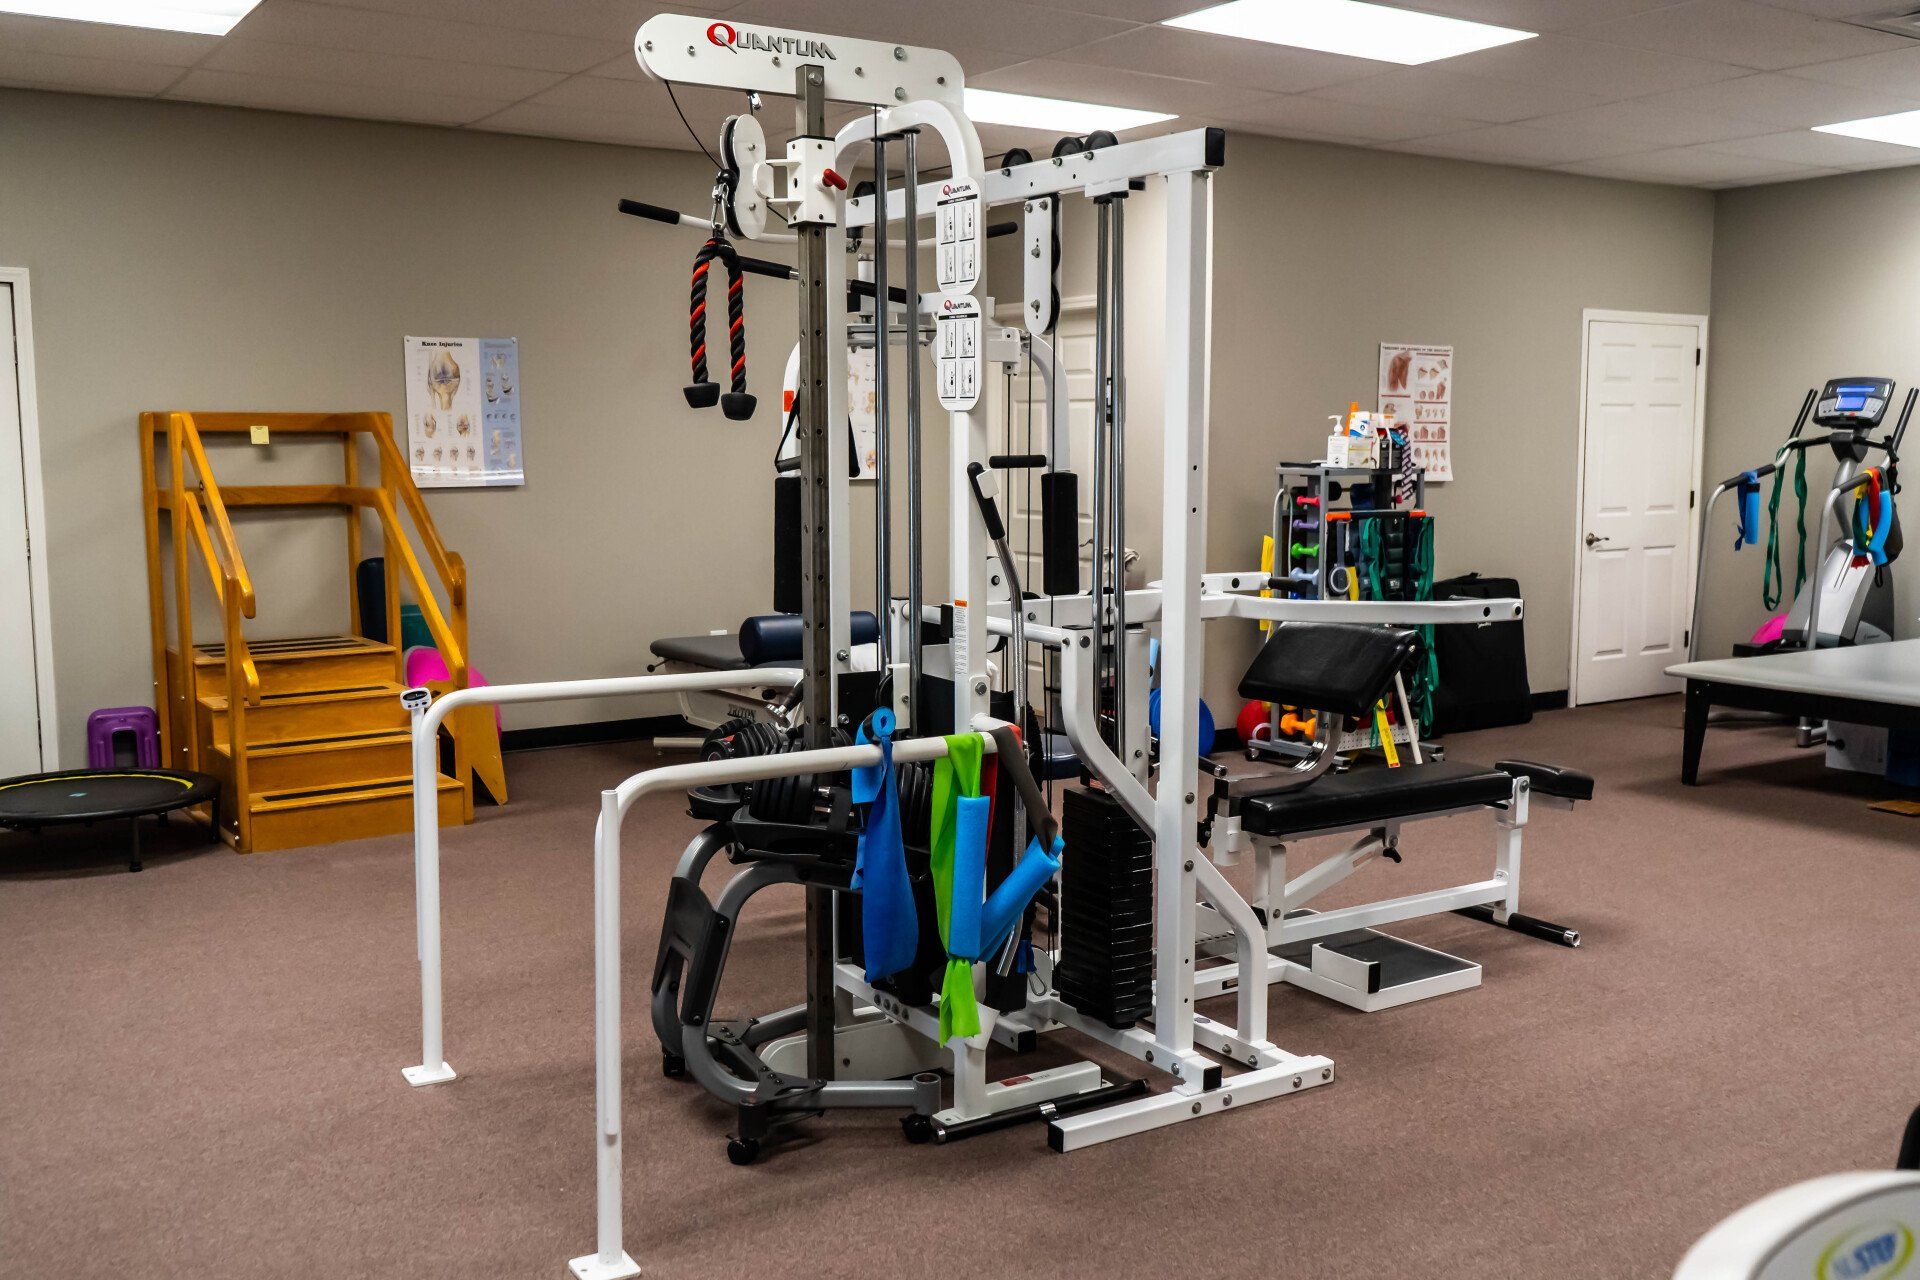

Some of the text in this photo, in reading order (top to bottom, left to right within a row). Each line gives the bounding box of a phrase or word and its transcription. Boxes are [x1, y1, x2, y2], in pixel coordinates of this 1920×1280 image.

[706, 22, 837, 60] QUANTUM
[943, 185, 972, 198] QUANTUM
[727, 703, 757, 723] TRITON
